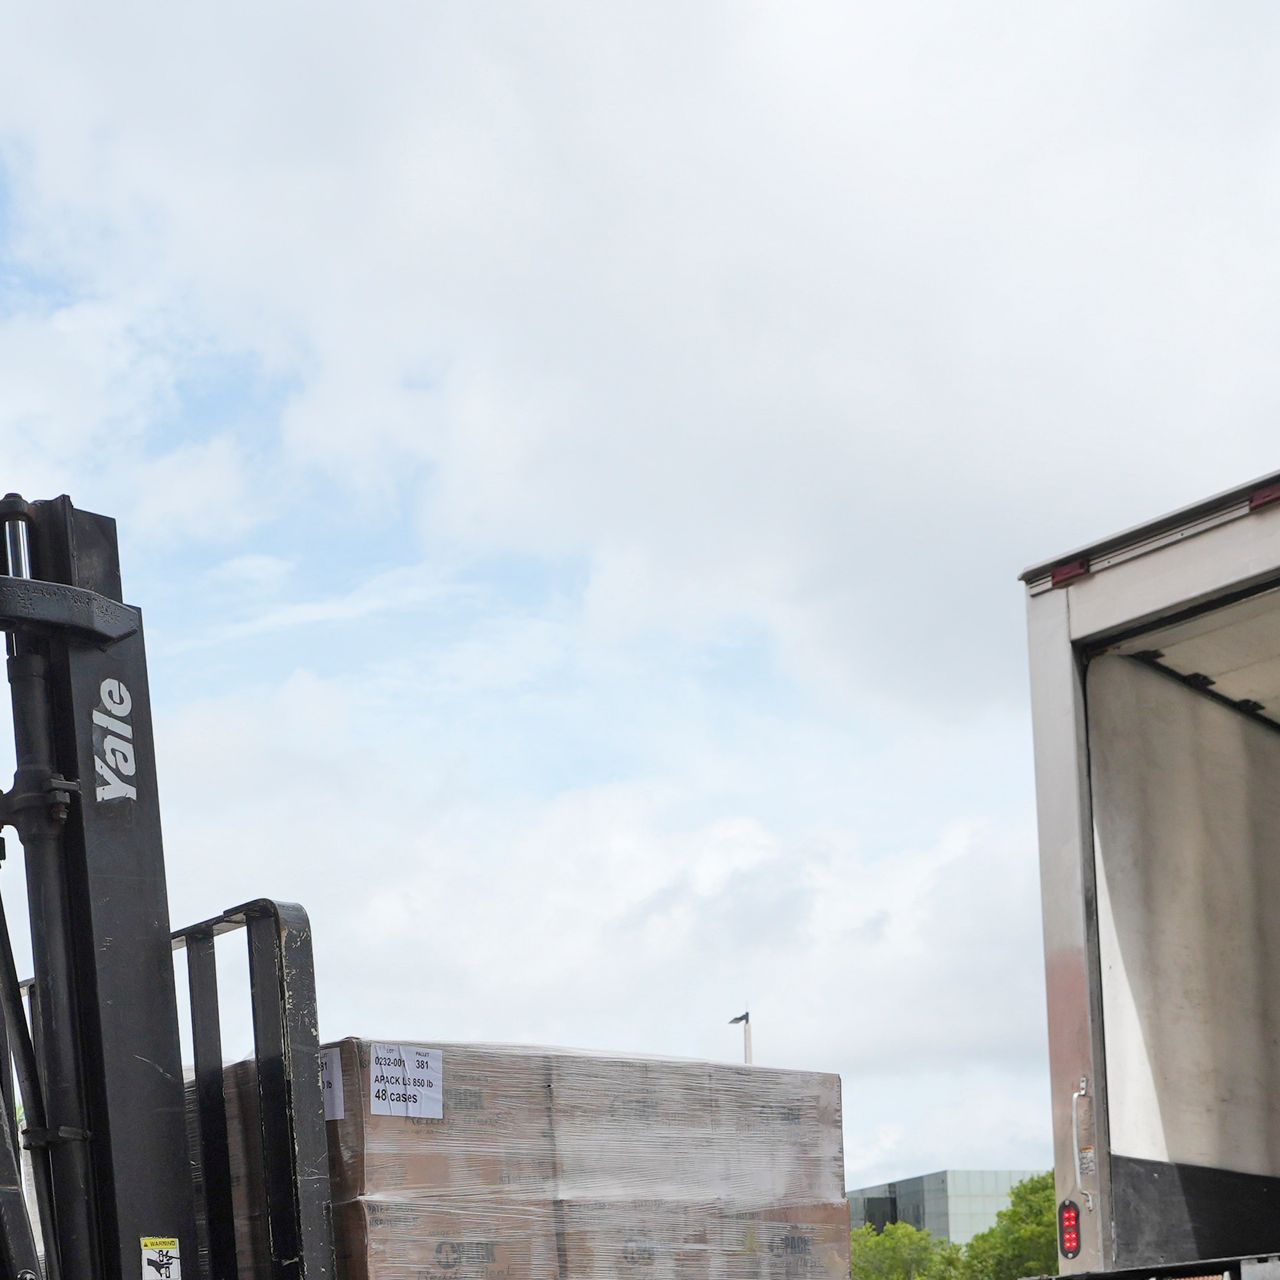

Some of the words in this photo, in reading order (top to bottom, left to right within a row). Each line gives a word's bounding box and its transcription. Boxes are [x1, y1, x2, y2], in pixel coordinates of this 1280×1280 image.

[92, 678, 137, 801] Yale
[374, 1056, 406, 1067] 0232-001
[415, 1060, 429, 1069] 381
[374, 1075, 401, 1086] APACK
[412, 1078, 425, 1088] 850
[426, 1079, 434, 1088] lb
[374, 1088, 387, 1101] 48
[389, 1091, 418, 1104] cases
